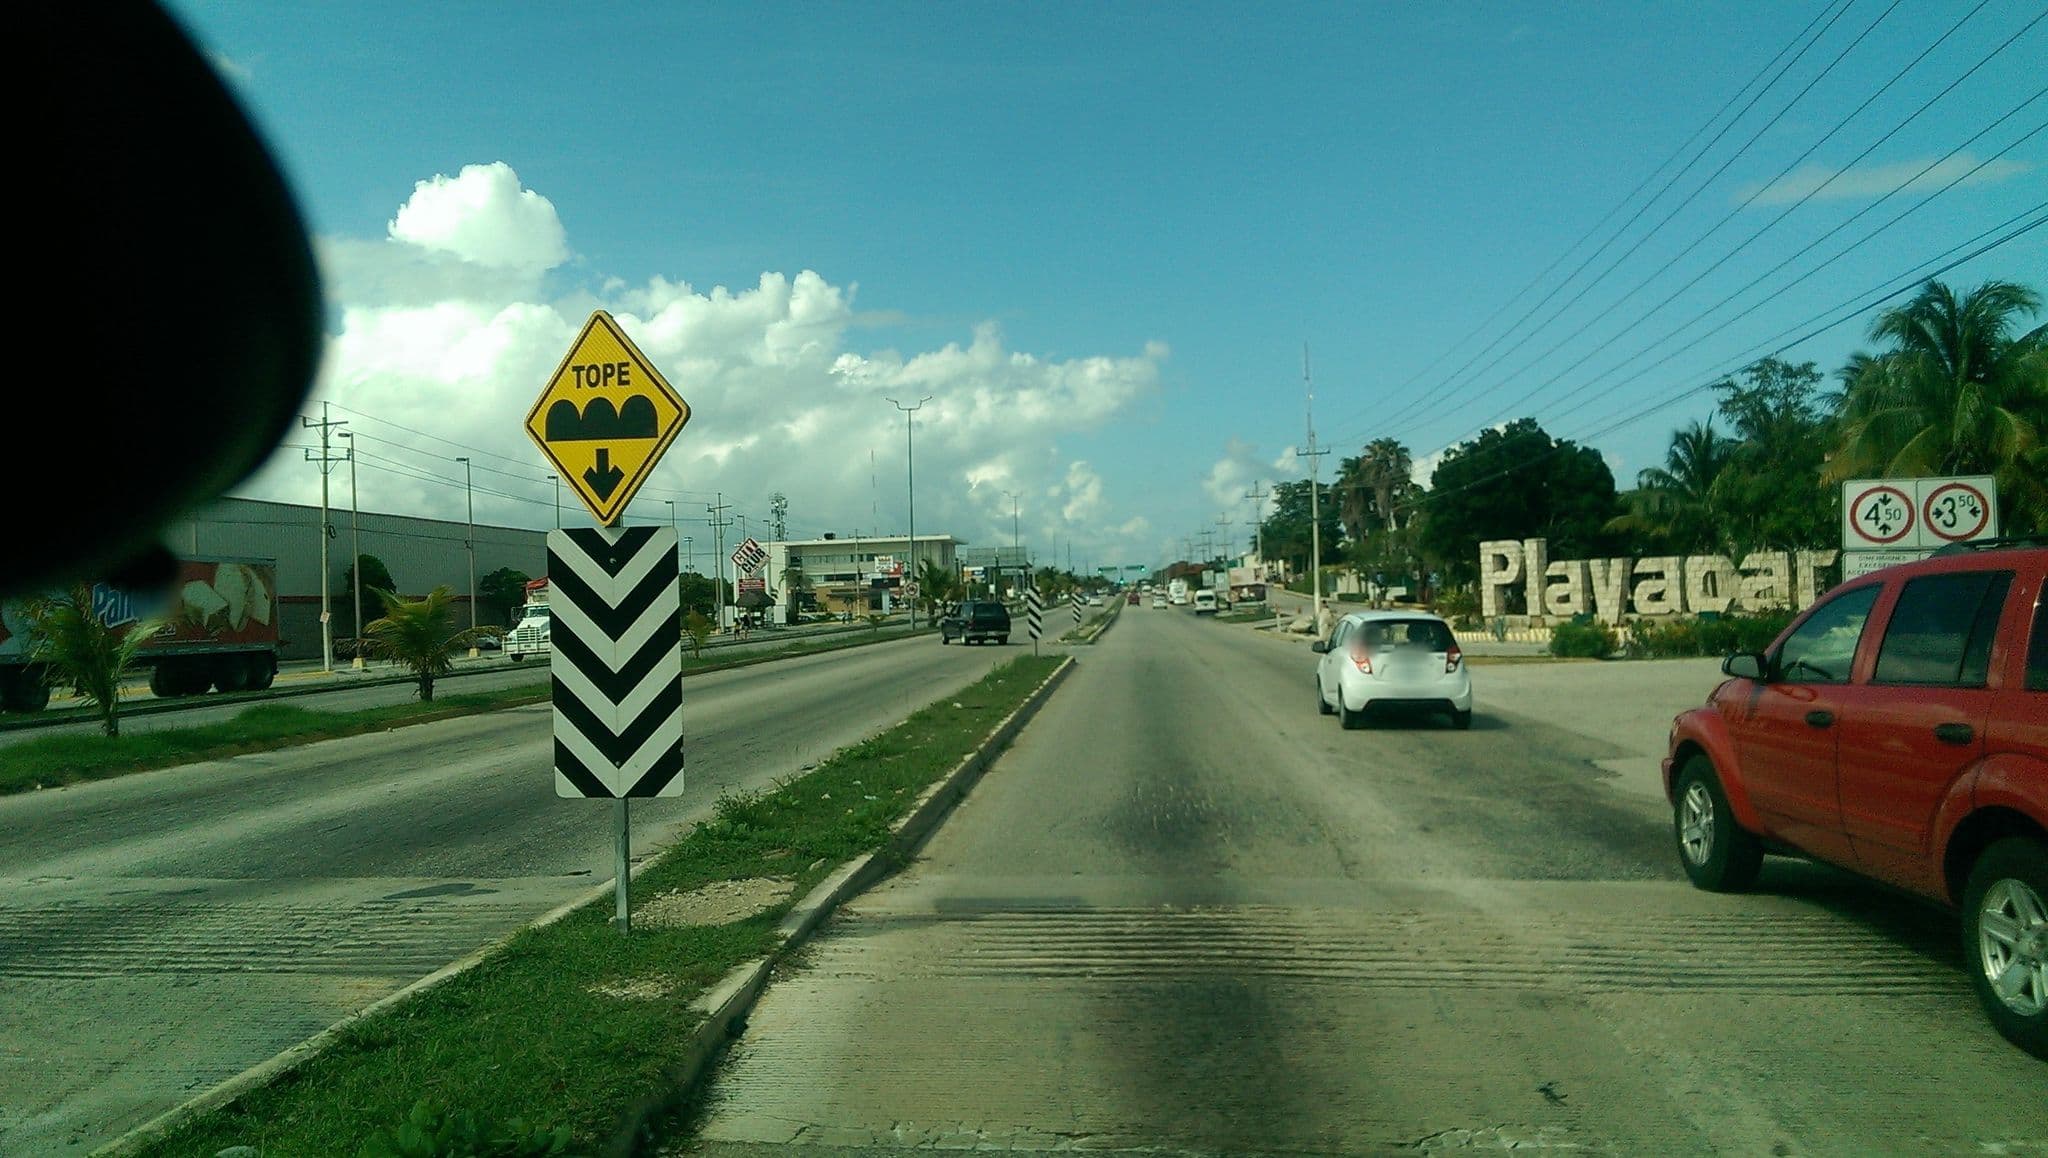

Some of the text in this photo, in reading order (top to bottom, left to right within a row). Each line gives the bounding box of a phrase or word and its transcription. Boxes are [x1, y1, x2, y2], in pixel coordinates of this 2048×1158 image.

[572, 362, 631, 389] TOPE
[734, 540, 758, 566] CITY
[741, 547, 766, 574] CLUB
